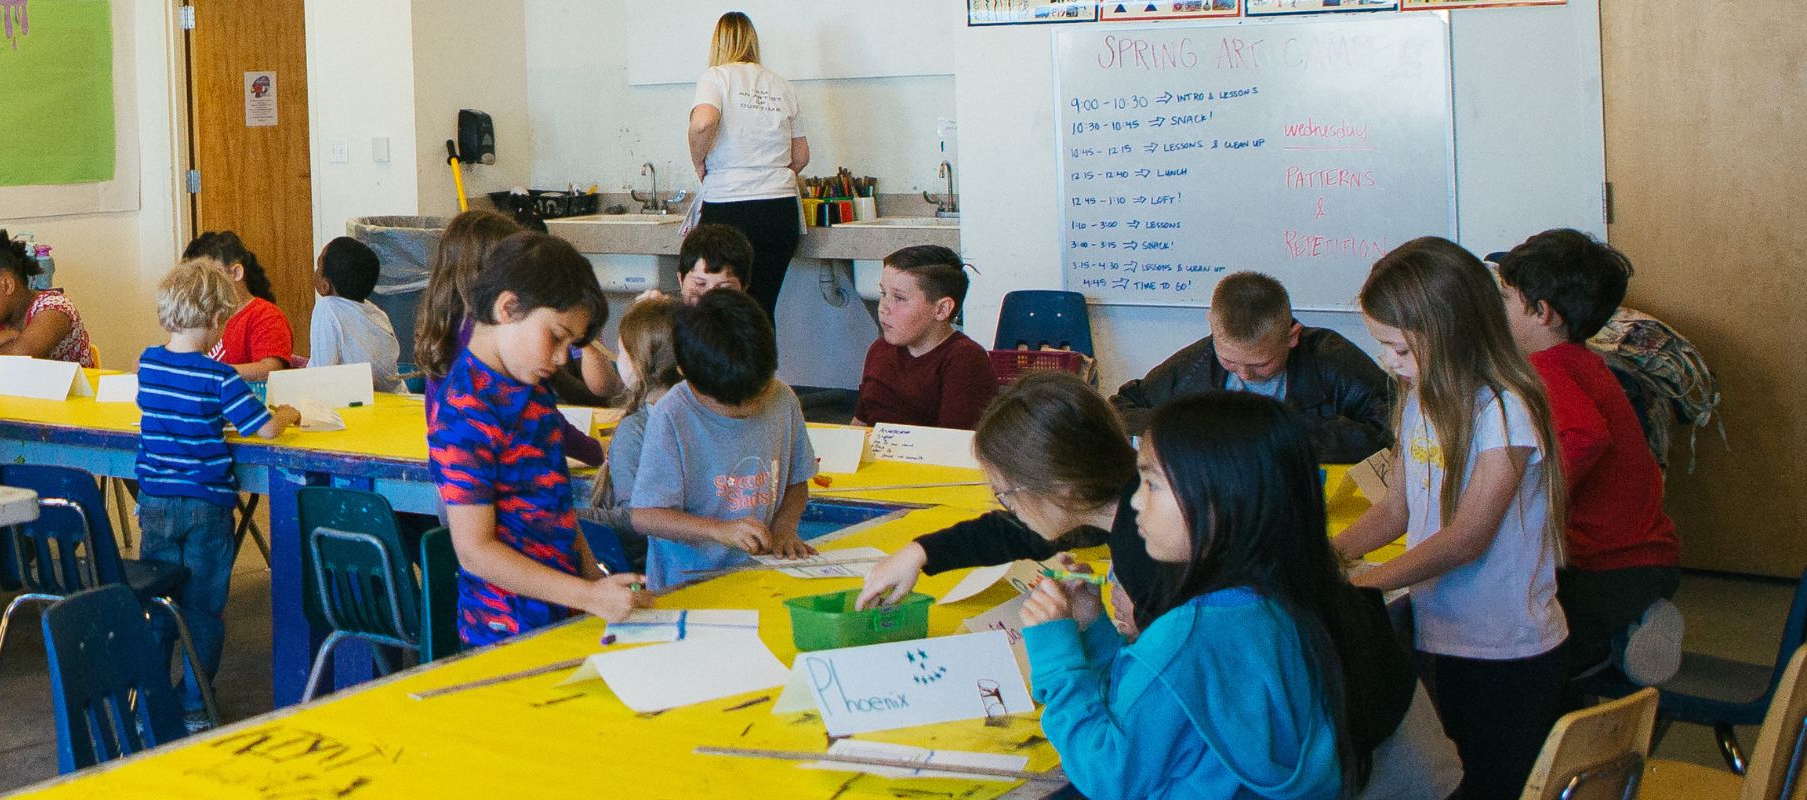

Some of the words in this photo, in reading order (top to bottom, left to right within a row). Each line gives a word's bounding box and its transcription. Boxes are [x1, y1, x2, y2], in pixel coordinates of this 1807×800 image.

[1097, 34, 1198, 71] SPRING
[1216, 38, 1264, 70] ART
[1177, 93, 1205, 103] INTRO
[1219, 87, 1259, 99] LESSONS
[1111, 119, 1140, 131] 10:45
[1164, 140, 1203, 152] LESSONS
[1224, 140, 1249, 149] CLEAN
[1253, 138, 1265, 147] UP
[1156, 168, 1188, 177] LUNCH
[1285, 167, 1376, 189] PATTERNS
[1315, 197, 1324, 219] &
[1145, 220, 1181, 229] LESSONS
[1285, 230, 1390, 260] REPETITION
[1141, 264, 1172, 272] LESSONS
[1134, 281, 1156, 290] TIME
[806, 656, 910, 717] Phoenix
